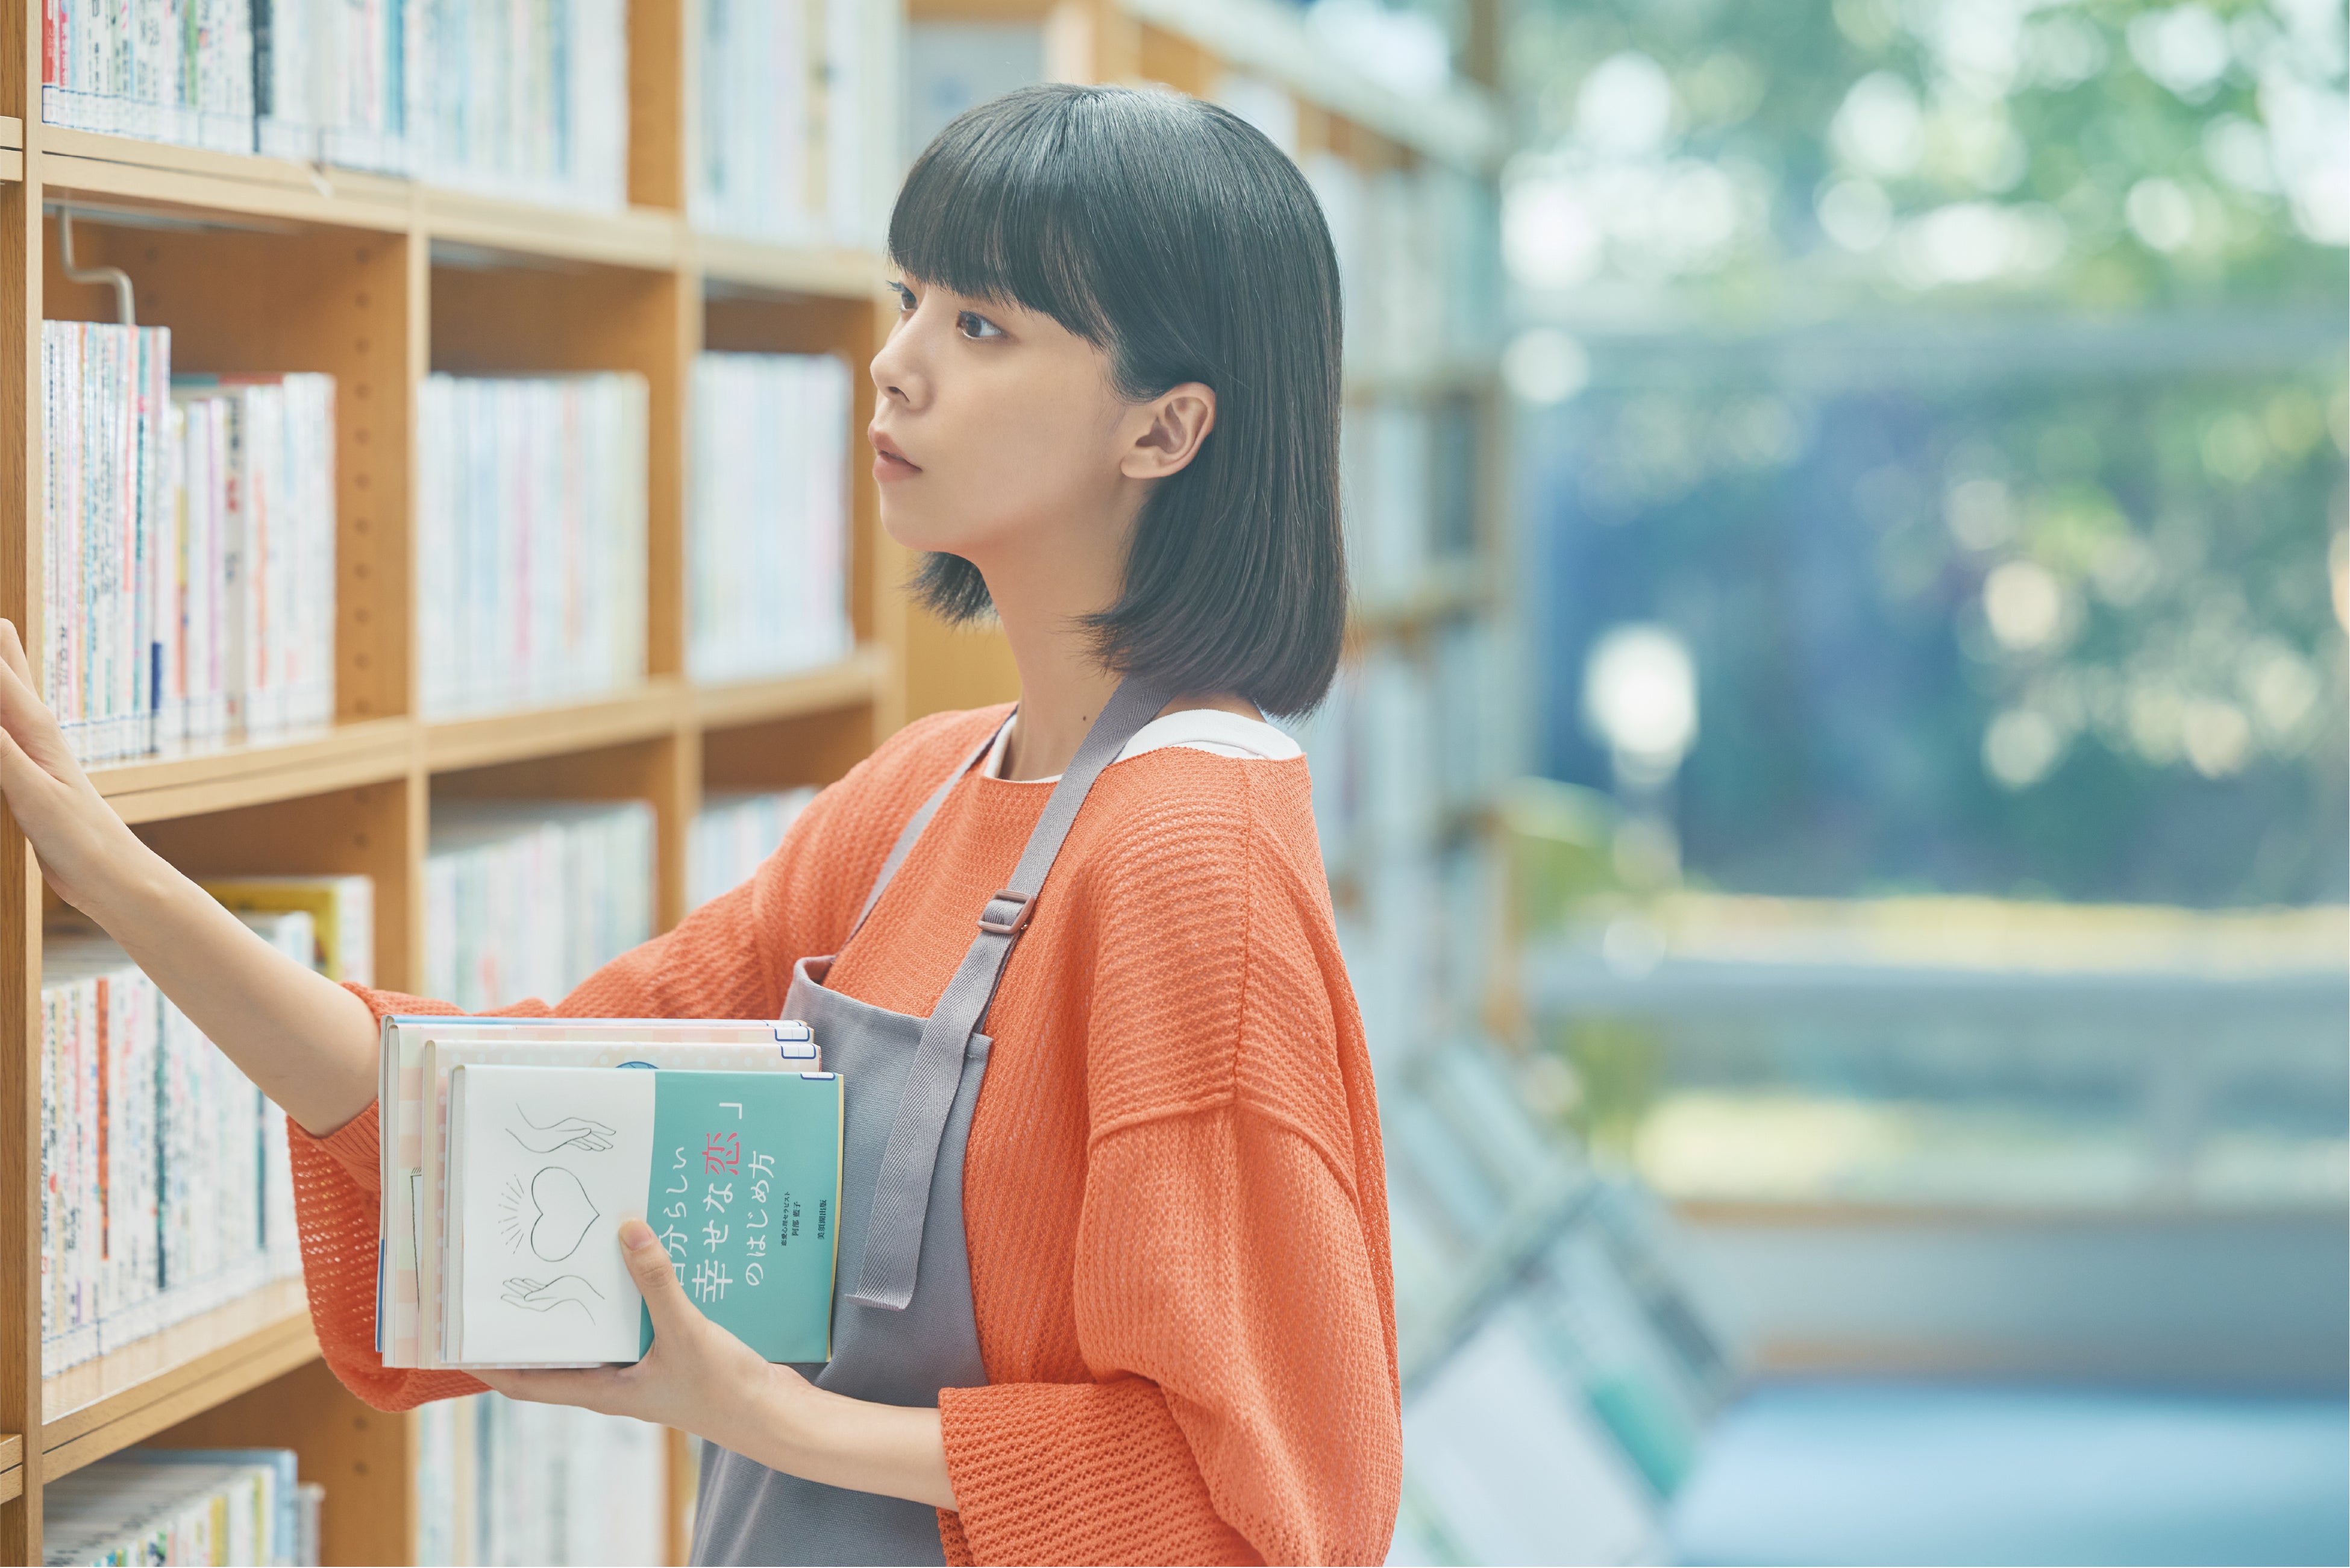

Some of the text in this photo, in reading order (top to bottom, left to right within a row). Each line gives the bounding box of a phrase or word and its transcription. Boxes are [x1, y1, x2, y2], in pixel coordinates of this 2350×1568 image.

[745, 1150, 775, 1286] のはじめ方
[781, 1191, 790, 1246] 恋愛心理セラピスト
[791, 1219, 800, 1236] 阿部
